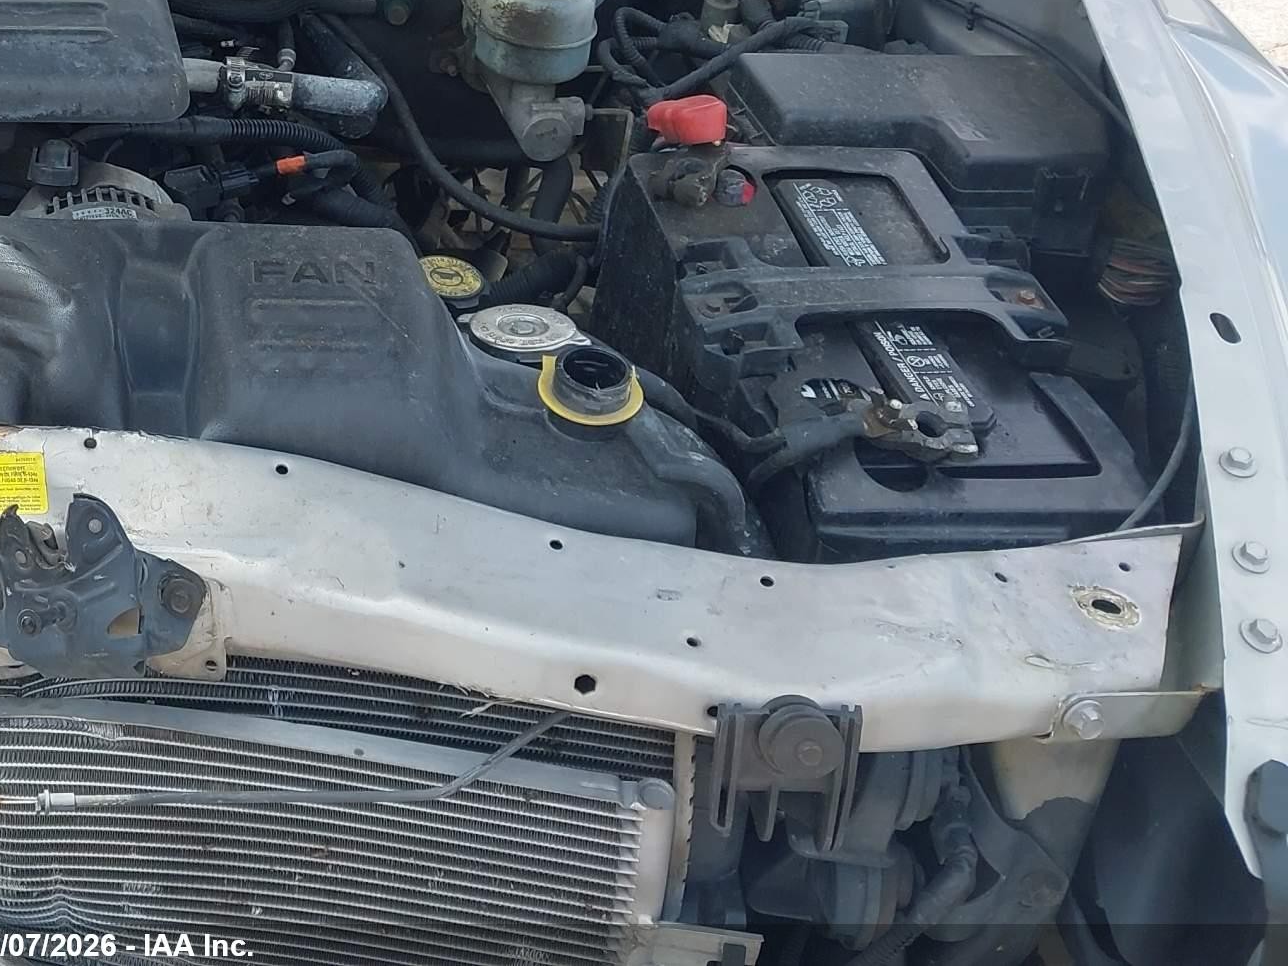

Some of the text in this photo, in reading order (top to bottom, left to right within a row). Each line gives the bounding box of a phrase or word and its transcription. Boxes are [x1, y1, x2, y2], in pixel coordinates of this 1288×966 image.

[251, 259, 377, 285] FAN
[872, 332, 900, 357] POISON
[896, 363, 926, 393] DANGER
